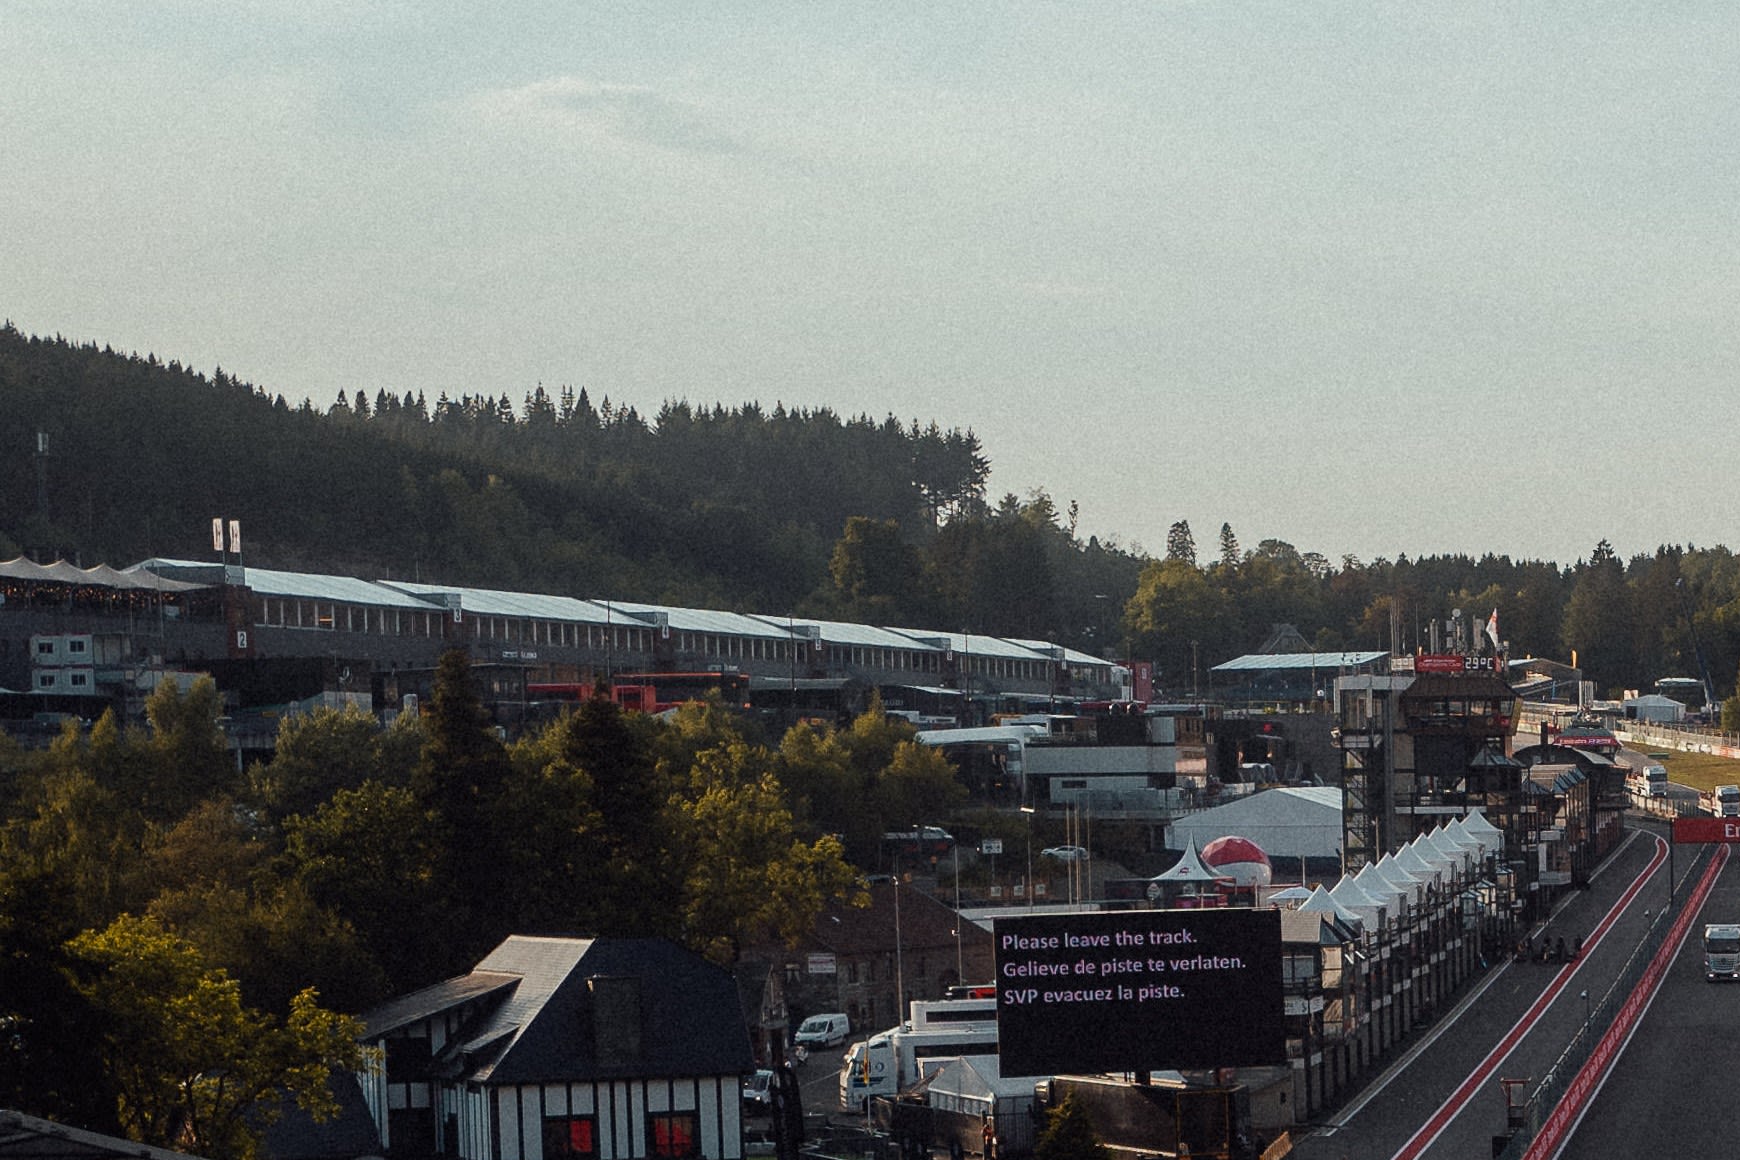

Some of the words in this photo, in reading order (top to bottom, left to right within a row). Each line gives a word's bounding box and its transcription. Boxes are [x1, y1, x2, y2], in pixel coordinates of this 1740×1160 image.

[1002, 934, 1059, 950] Please
[1064, 932, 1110, 948] leave
[1115, 930, 1144, 946] the
[1149, 928, 1197, 945] track.
[1003, 960, 1069, 977] Gelieve
[1074, 959, 1095, 974] de
[1101, 957, 1143, 977] piste
[1147, 957, 1165, 972] te
[1169, 954, 1247, 972] verlaten.
[1004, 988, 1038, 1005] SVP
[1043, 988, 1113, 1003] evacuez
[1118, 984, 1133, 1000] la
[1138, 983, 1185, 1002] piste.
